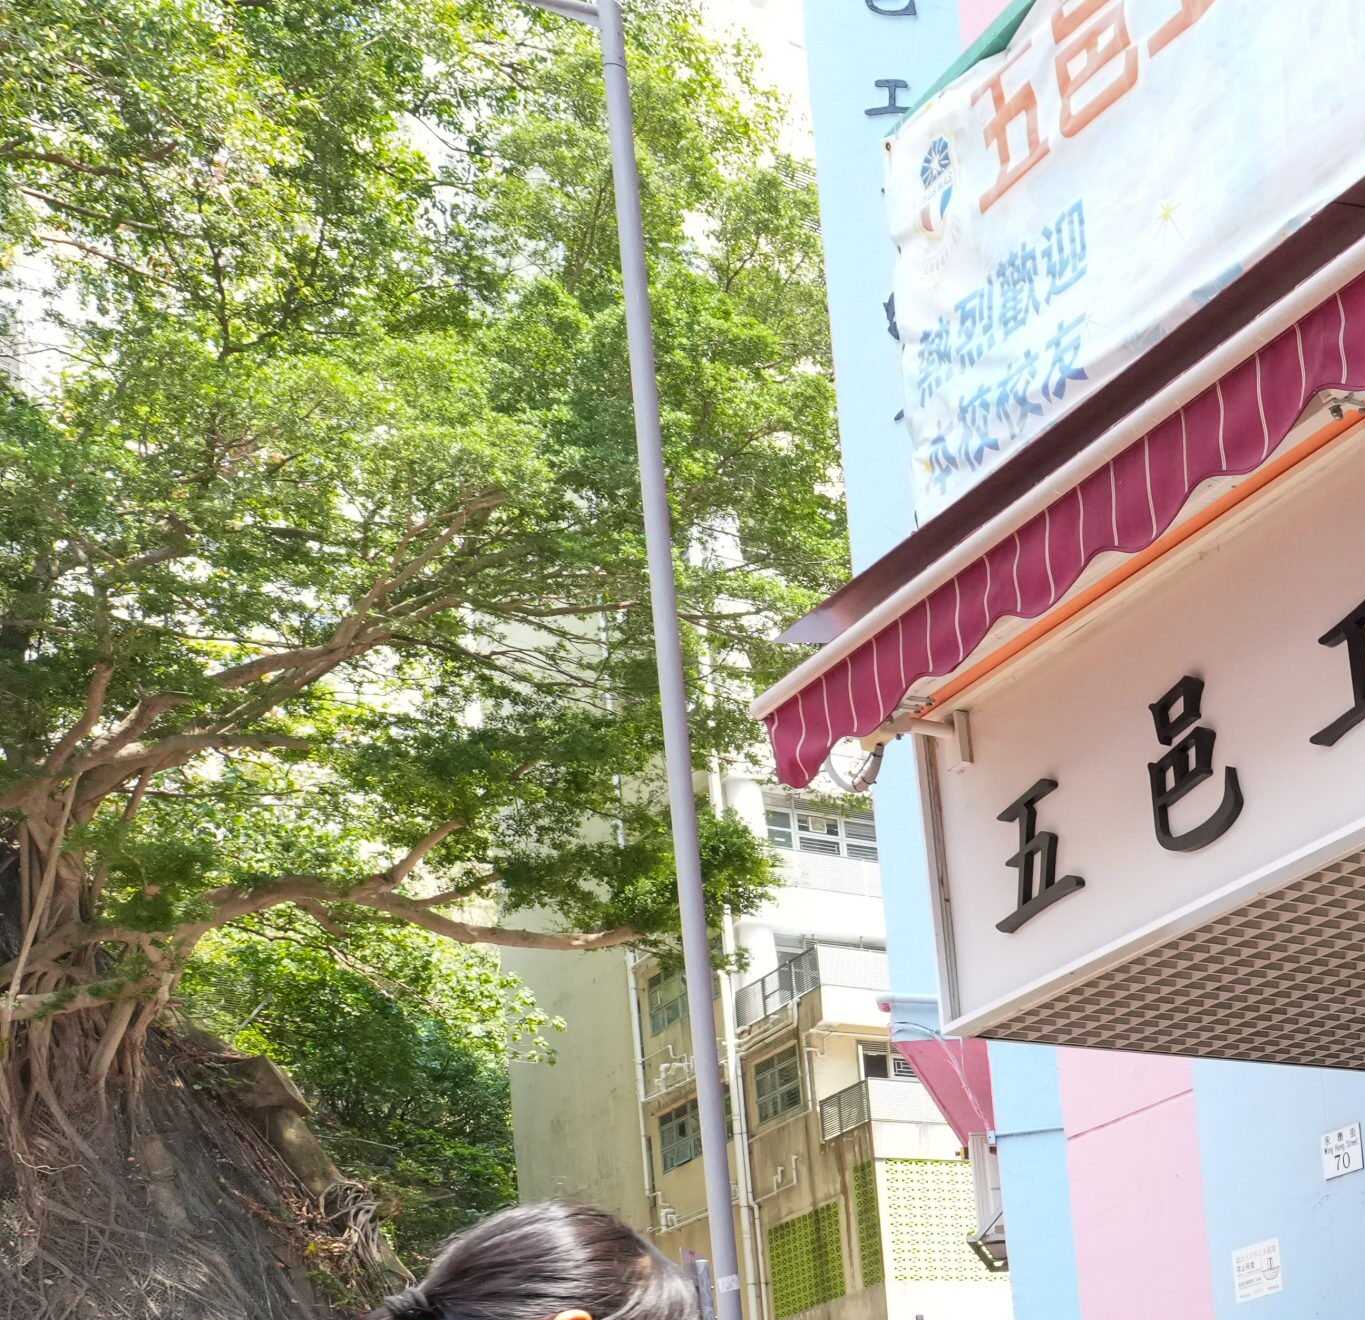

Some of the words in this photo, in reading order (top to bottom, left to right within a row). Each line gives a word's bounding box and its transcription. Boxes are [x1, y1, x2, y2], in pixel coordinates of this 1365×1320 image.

[917, 198, 1088, 408] 熱烈歡迎
[925, 313, 1089, 495] 本校校友
[1334, 1151, 1351, 1171] 70
